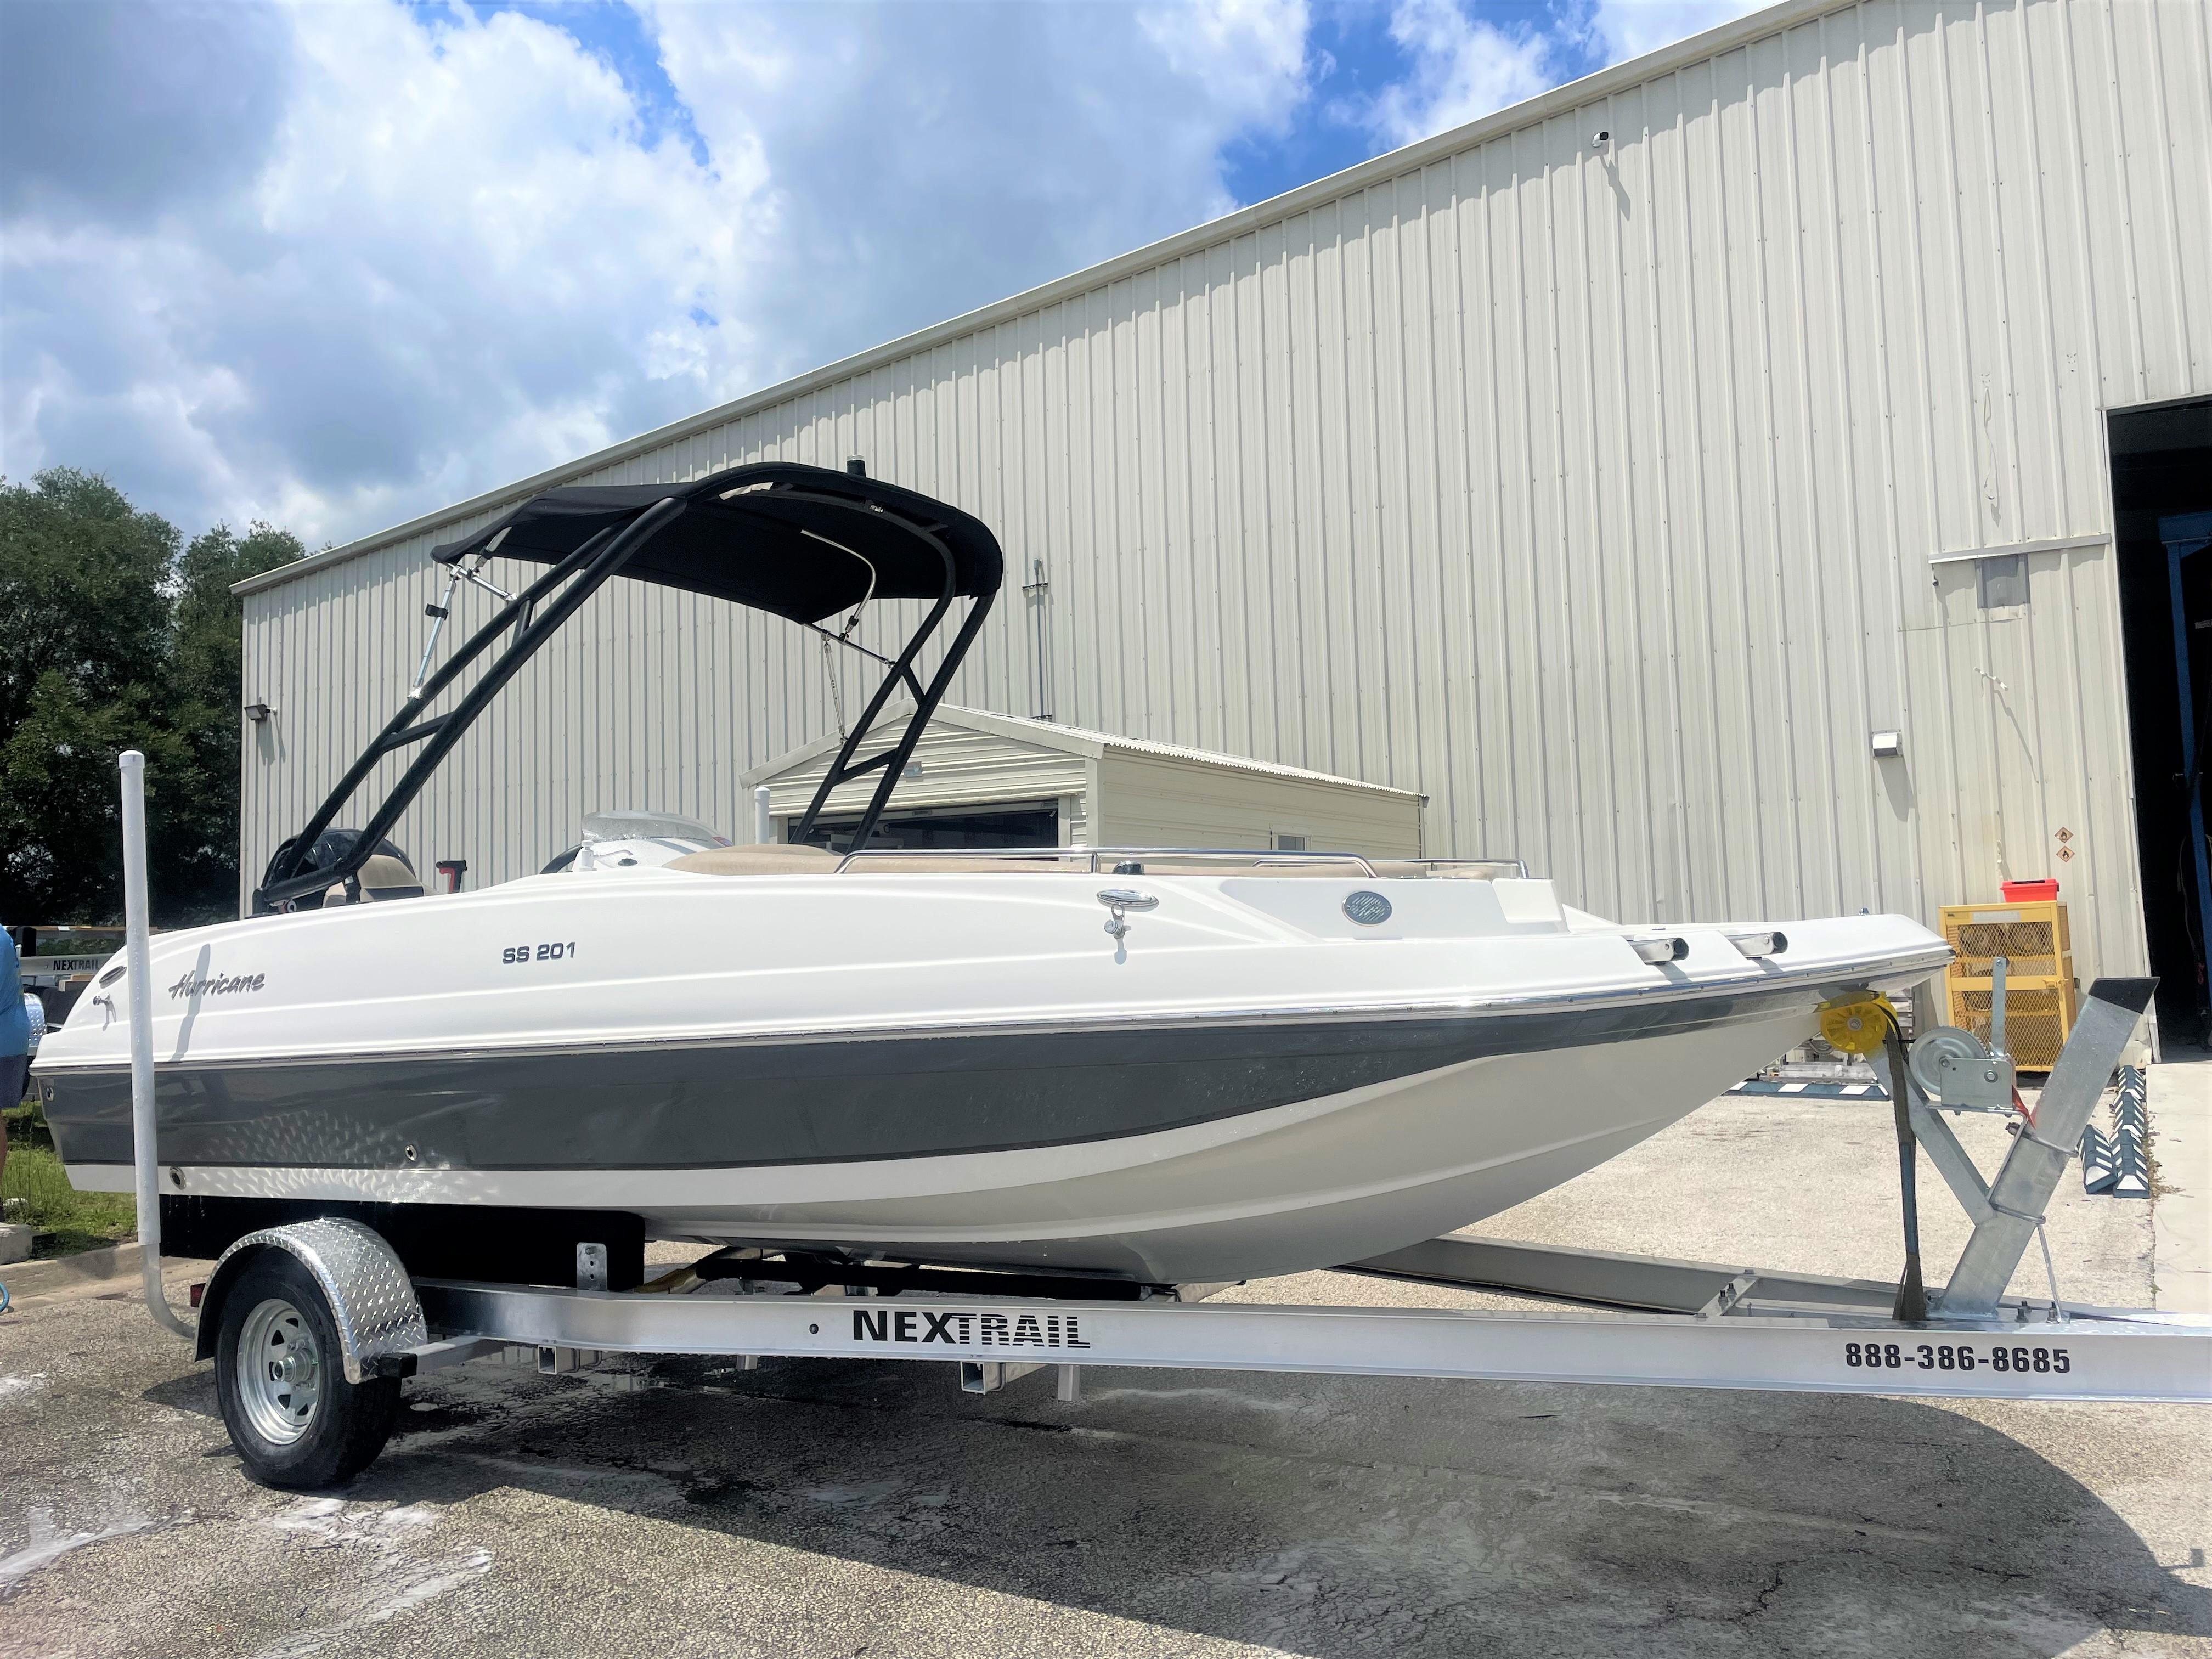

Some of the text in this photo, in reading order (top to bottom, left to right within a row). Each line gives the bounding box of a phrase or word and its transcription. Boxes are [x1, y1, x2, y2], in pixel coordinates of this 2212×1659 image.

[53, 959, 99, 970] NEXTRAIL
[502, 941, 575, 964] SS 201
[168, 969, 266, 1000] Hurricane
[853, 1310, 1091, 1349] NEXTRAIL
[1845, 1342, 2071, 1373] 888-386-8685
